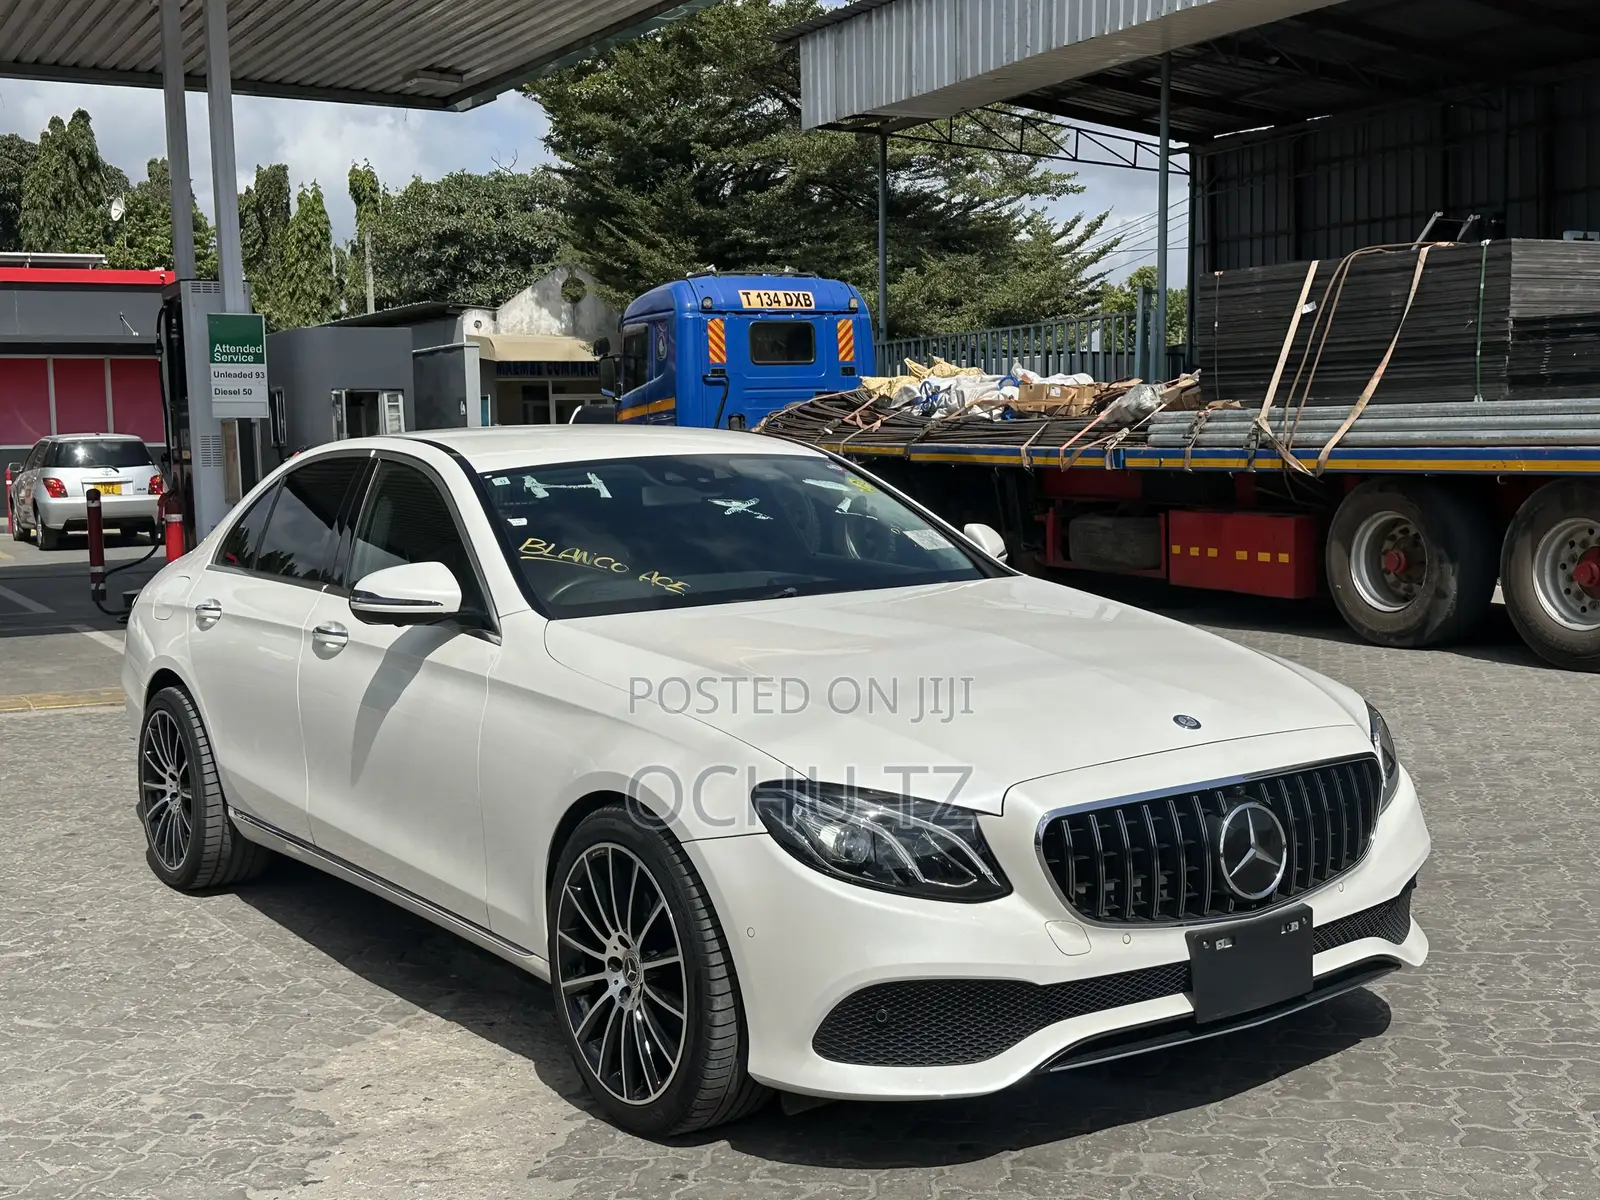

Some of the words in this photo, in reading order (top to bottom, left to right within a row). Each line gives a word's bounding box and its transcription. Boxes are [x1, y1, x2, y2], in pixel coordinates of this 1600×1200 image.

[742, 291, 751, 306] T
[756, 292, 781, 307] 134
[783, 292, 813, 307] DXB
[213, 343, 263, 353] Attended
[213, 352, 254, 362] Service
[213, 371, 253, 379] Unleaded
[255, 371, 266, 379] 93
[214, 388, 240, 396] Diesel
[242, 388, 252, 396] 50
